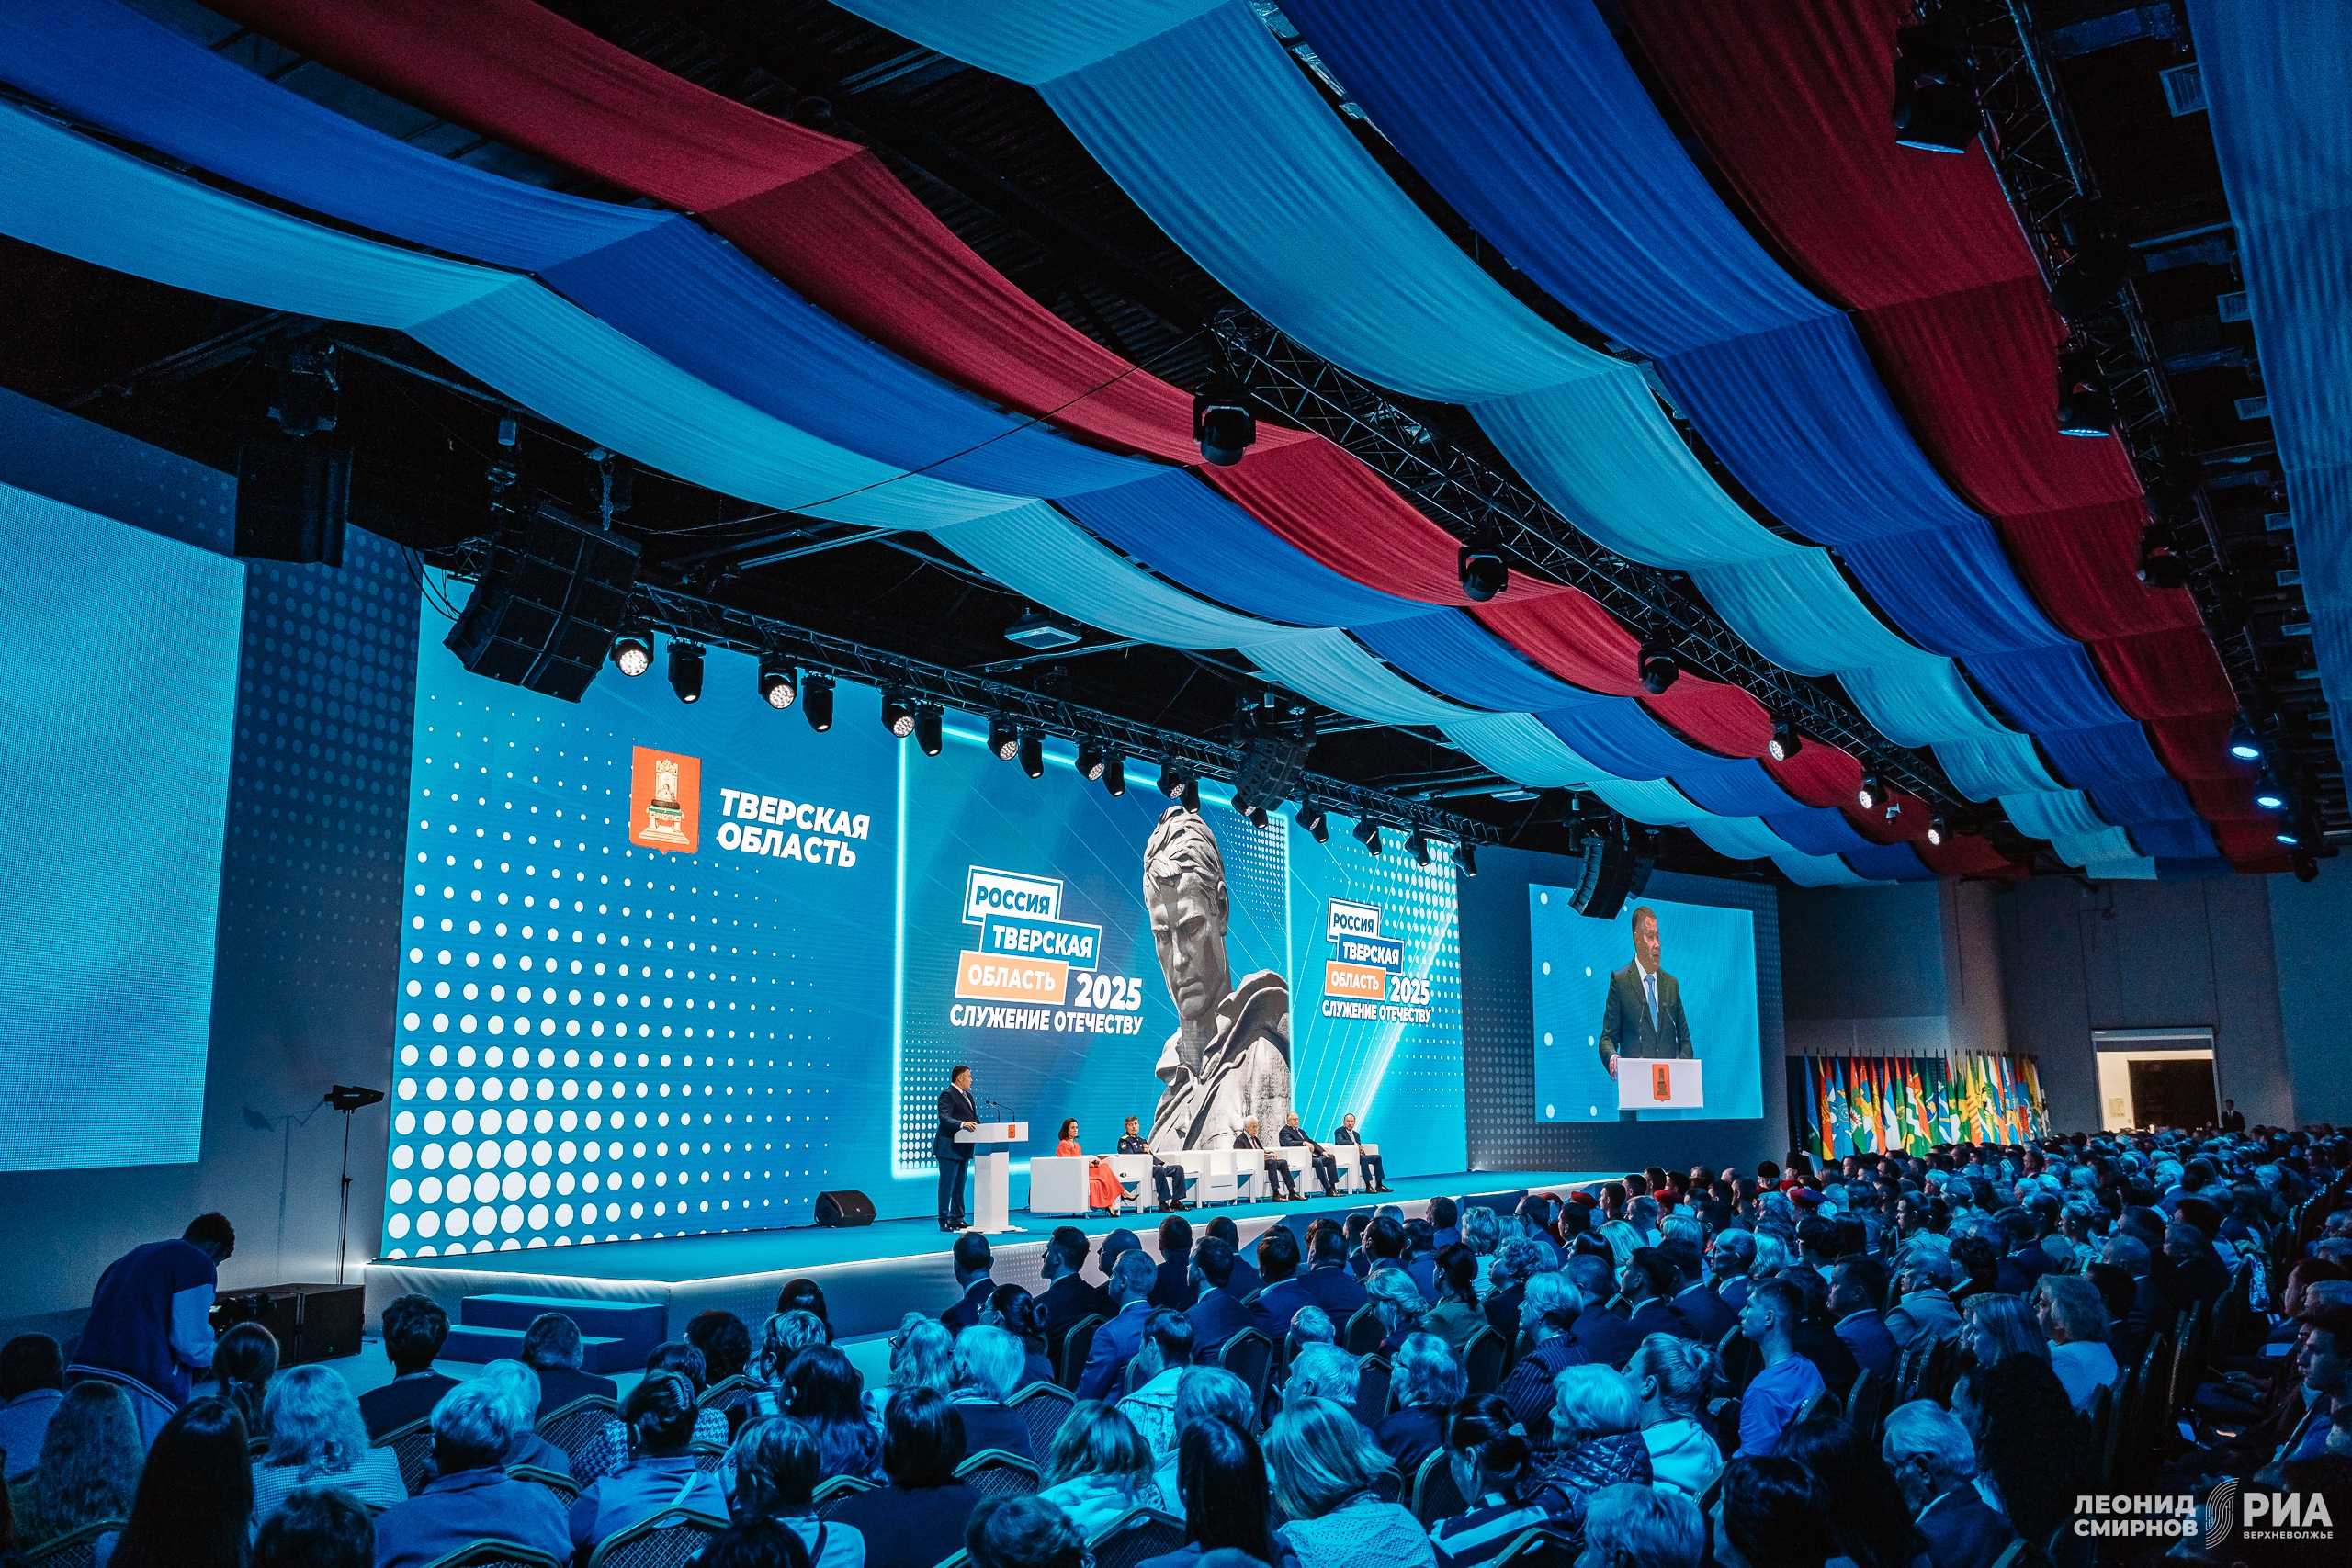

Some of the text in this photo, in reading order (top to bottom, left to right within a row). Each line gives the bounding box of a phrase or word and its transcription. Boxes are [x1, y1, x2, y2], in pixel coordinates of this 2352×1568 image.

[720, 788, 870, 840] ТВЕРСКАЯ
[718, 822, 856, 868] ОБЛАСТЬ
[975, 886, 1051, 915] РОССИЯ
[1333, 913, 1374, 933] РОССИЯ
[992, 925, 1093, 958] ТВЕРСКАЯ
[1342, 942, 1399, 965] ТВЕРСКАЯ
[967, 964, 1056, 992] ОБЛАСТЬ
[1074, 973, 1142, 1010] 2025
[1330, 971, 1379, 991] ОБЛАСТЬ
[1390, 976, 1430, 1005] 2025
[949, 1004, 1143, 1035] СЛУЖЕНИЕ ОТЕЧЕСТВУ
[1322, 999, 1431, 1023] СЛУЖЕНИЕ ОТЕЧЕСТВУ
